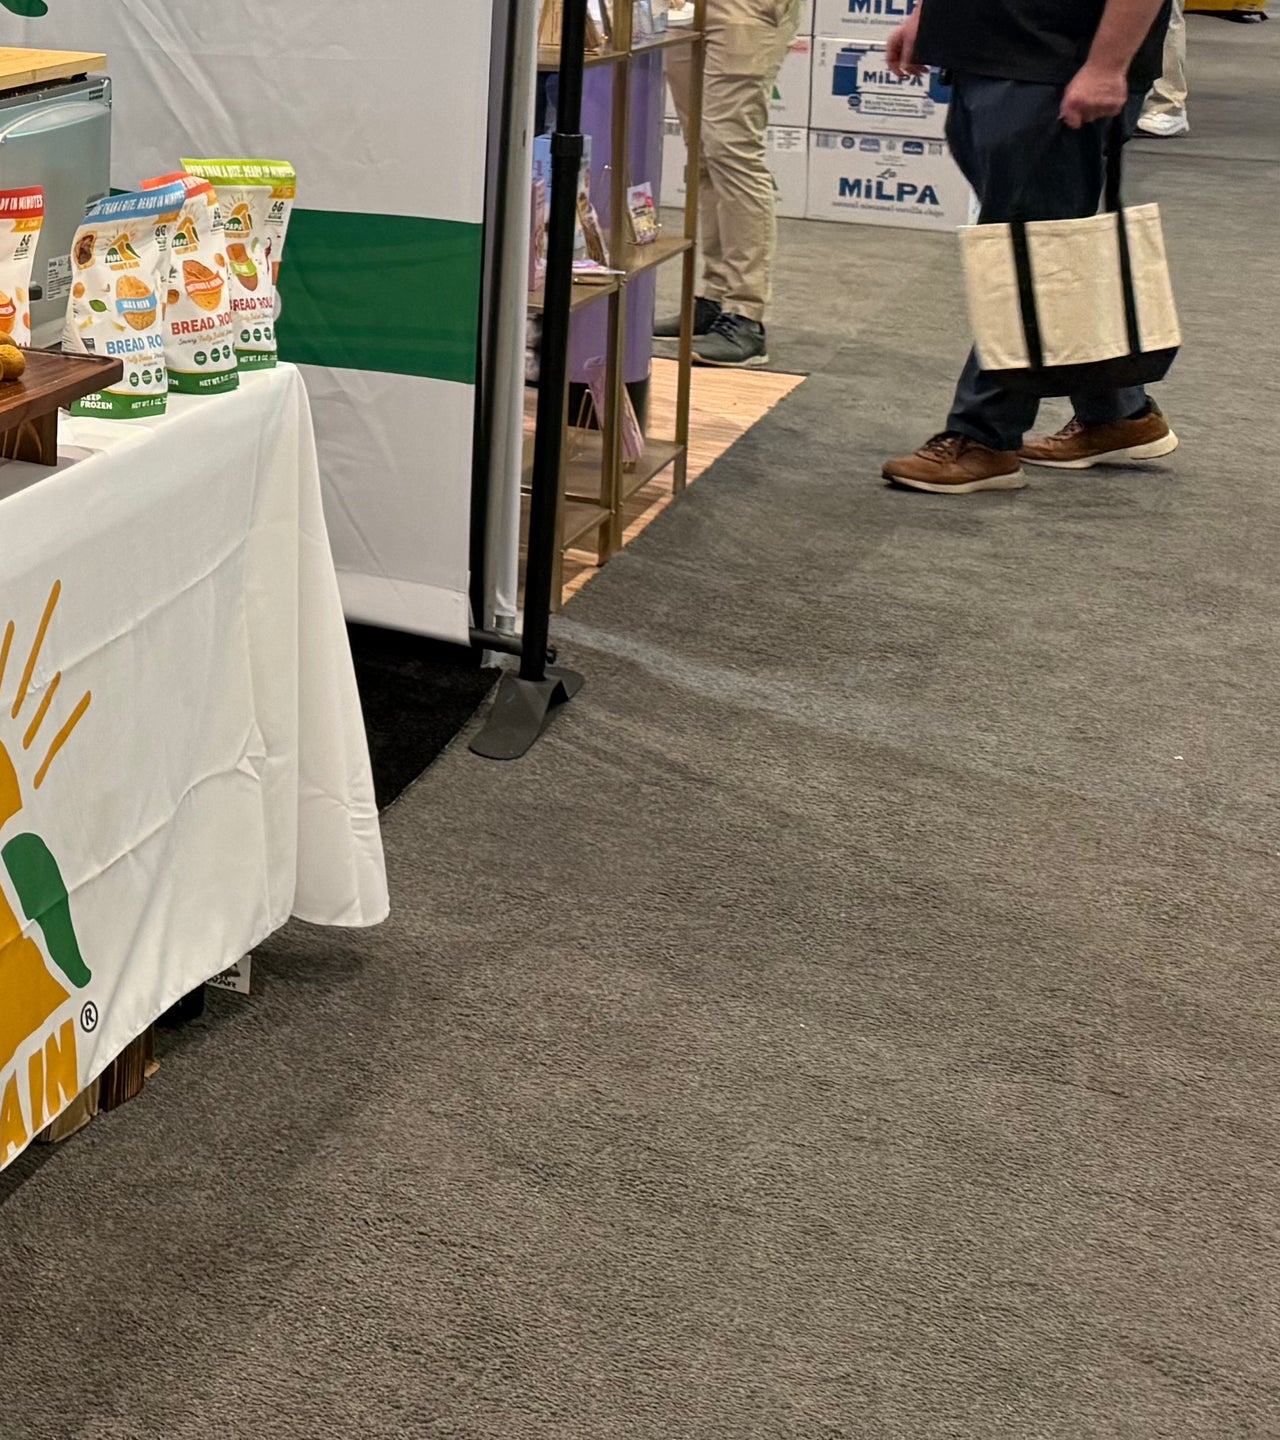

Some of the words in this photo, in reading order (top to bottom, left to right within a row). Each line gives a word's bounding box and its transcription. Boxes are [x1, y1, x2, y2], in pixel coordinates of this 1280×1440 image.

[839, 177, 939, 205] MiLPA
[230, 296, 256, 311] BREAD
[171, 316, 215, 336] BREAD
[106, 337, 144, 355] BREAD
[80, 400, 113, 410] FROZEN
